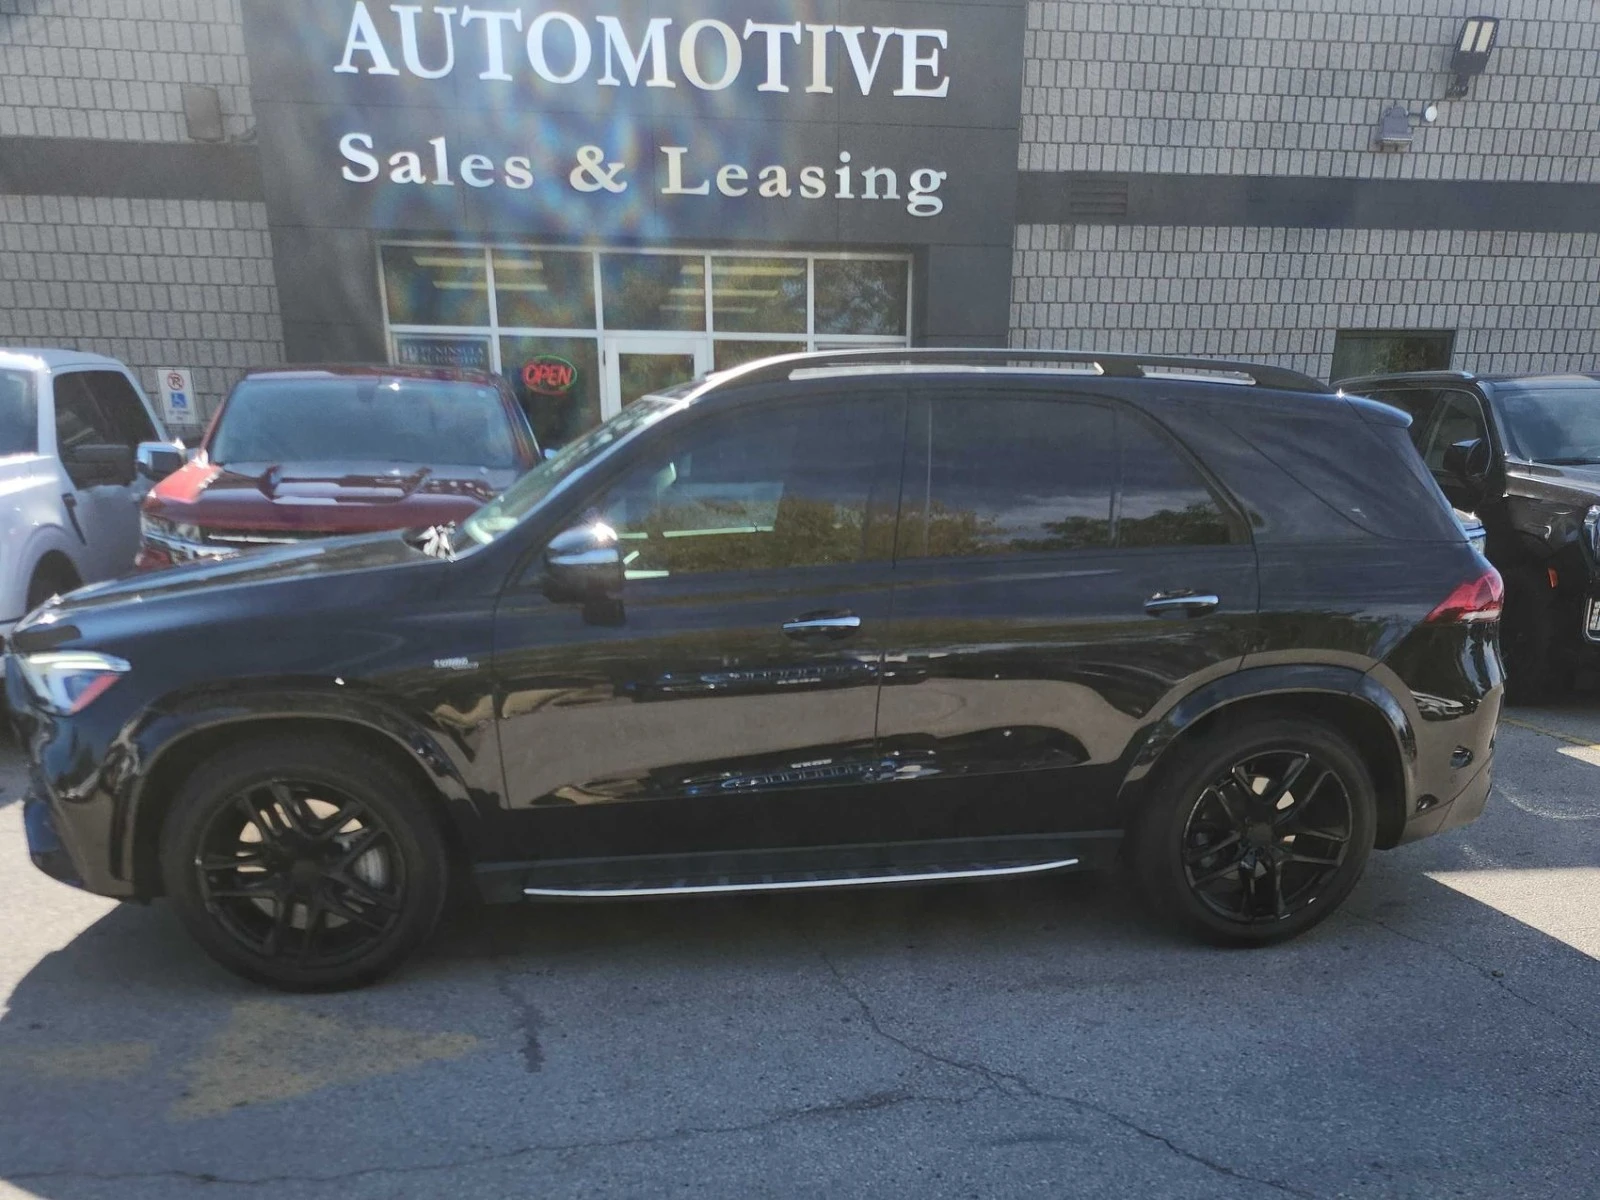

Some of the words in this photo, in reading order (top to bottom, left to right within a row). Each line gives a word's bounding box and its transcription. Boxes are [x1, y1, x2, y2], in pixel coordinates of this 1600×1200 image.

[333, 1, 949, 98] AUTOMOTIVE
[339, 132, 534, 190] Sales
[569, 145, 627, 193] &
[660, 146, 948, 217] Leasing
[524, 364, 573, 386] OPEN
